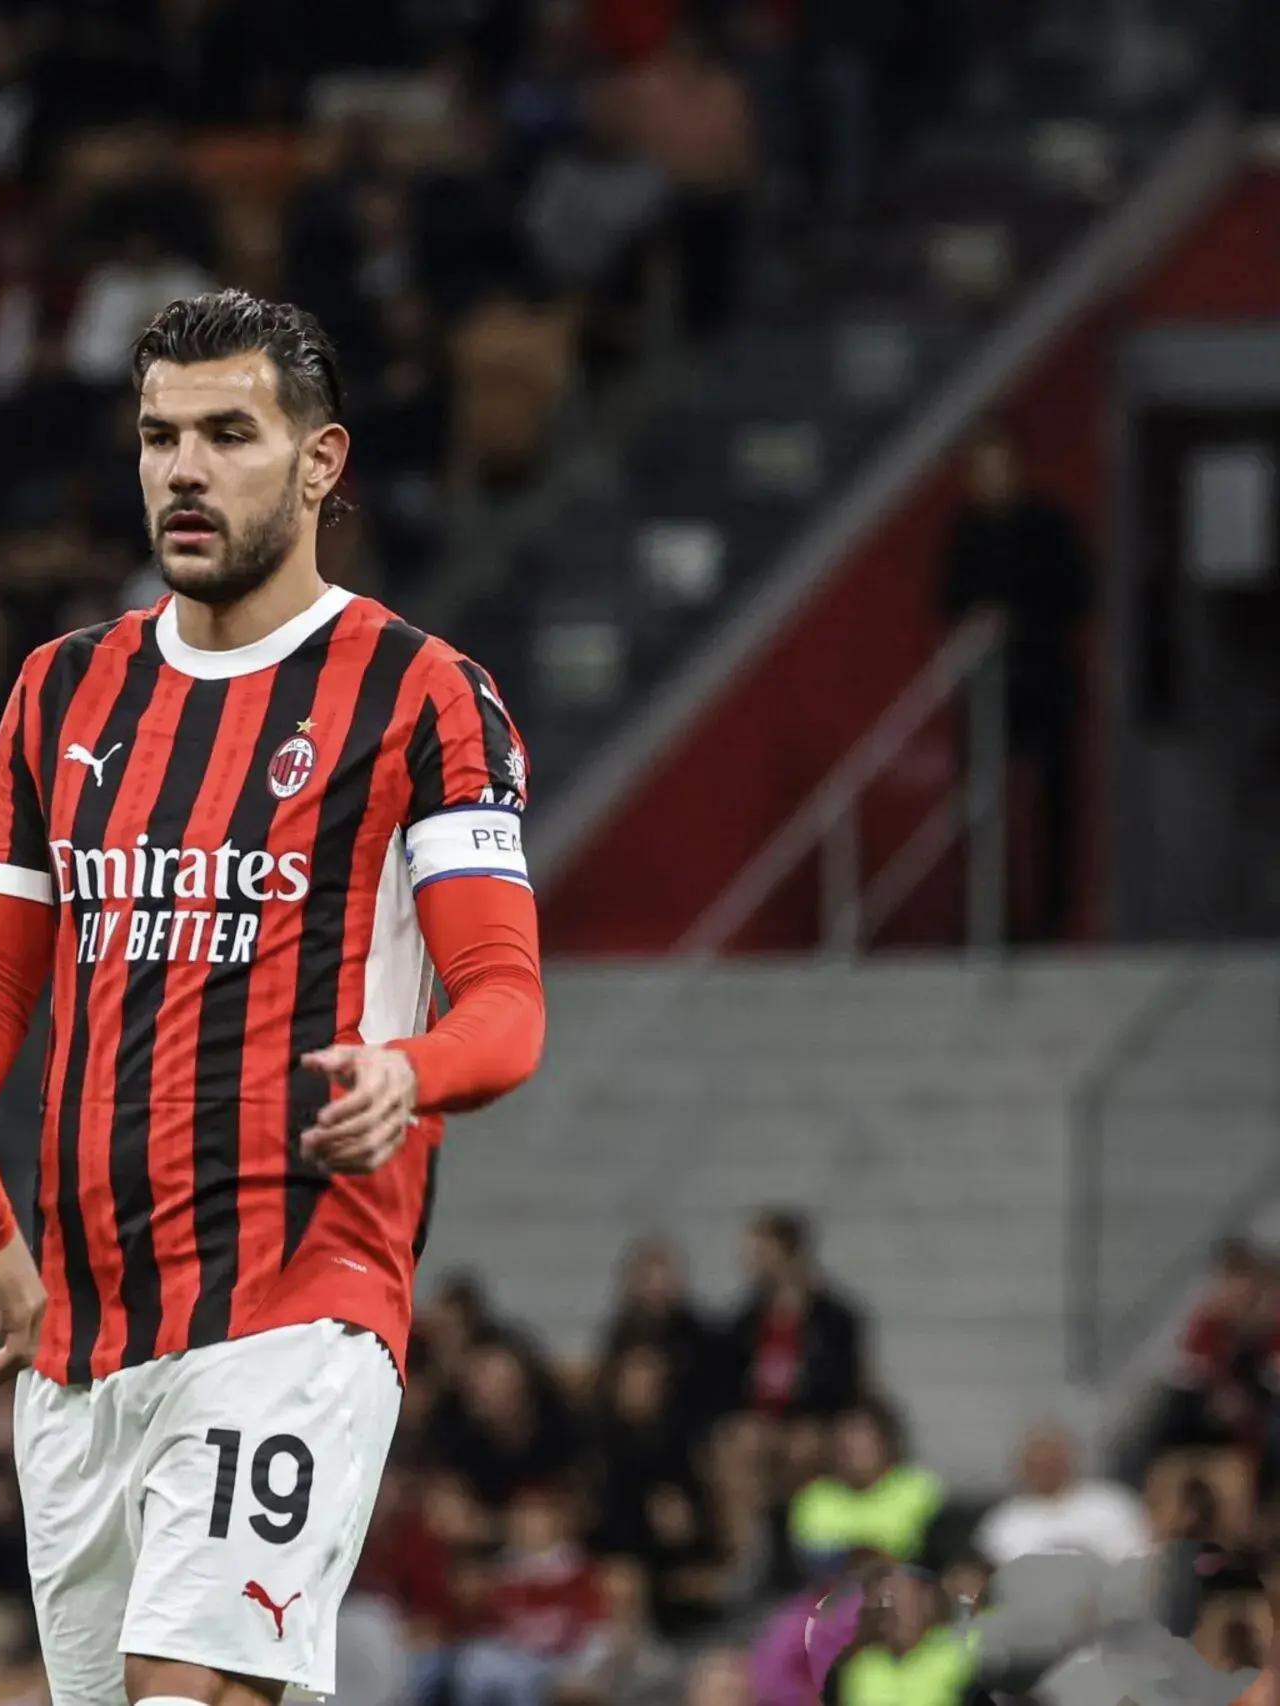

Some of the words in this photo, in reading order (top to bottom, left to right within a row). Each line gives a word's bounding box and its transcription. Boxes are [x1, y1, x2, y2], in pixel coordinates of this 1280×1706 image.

[49, 833, 309, 902] Emirates
[78, 911, 121, 964] FLY
[124, 910, 259, 963] BETTER
[205, 1428, 314, 1544] 19
